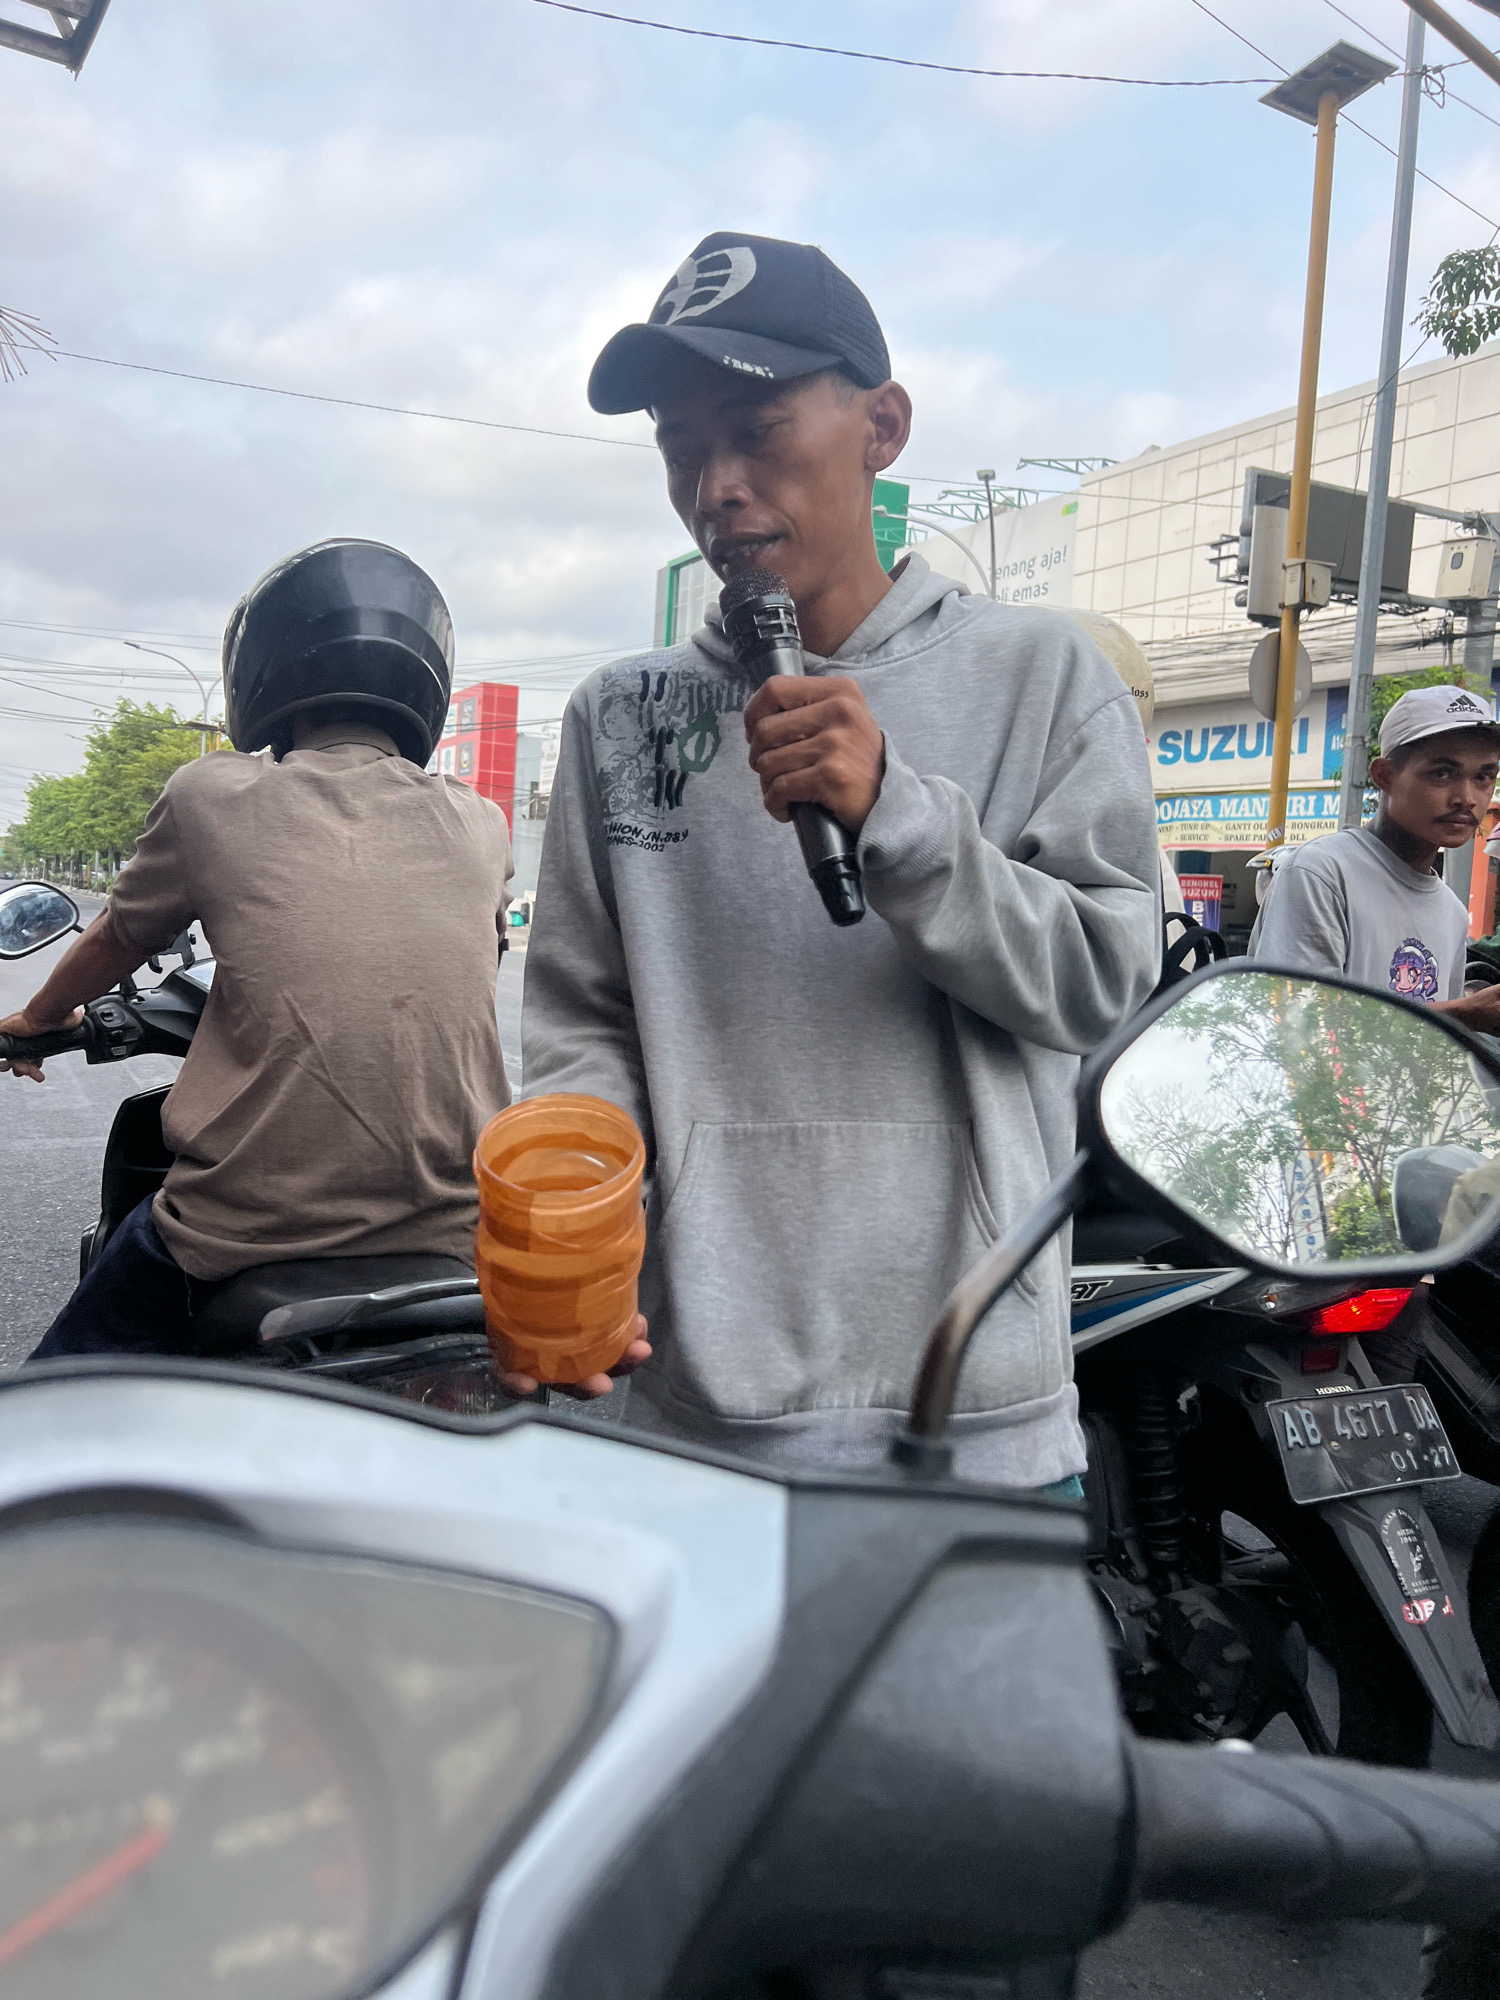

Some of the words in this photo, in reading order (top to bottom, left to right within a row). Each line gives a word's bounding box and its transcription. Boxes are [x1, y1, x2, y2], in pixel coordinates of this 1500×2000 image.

[994, 555, 1037, 579] enang
[1040, 544, 1067, 571] aja!
[1012, 581, 1049, 602] emas
[1218, 795, 1316, 818] MANIRI
[1200, 823, 1211, 831] UP
[1225, 822, 1250, 831] GANTI
[1291, 821, 1336, 830] BONGKAR
[1179, 833, 1210, 842] SERVICE
[1224, 833, 1250, 842] SPARE
[1290, 833, 1307, 842] DLL
[1181, 879, 1219, 888] BENGKEL
[1316, 1385, 1353, 1395] HONDA
[1279, 1407, 1322, 1450] AB
[1333, 1400, 1398, 1440] 4677
[1404, 1395, 1438, 1430] DA
